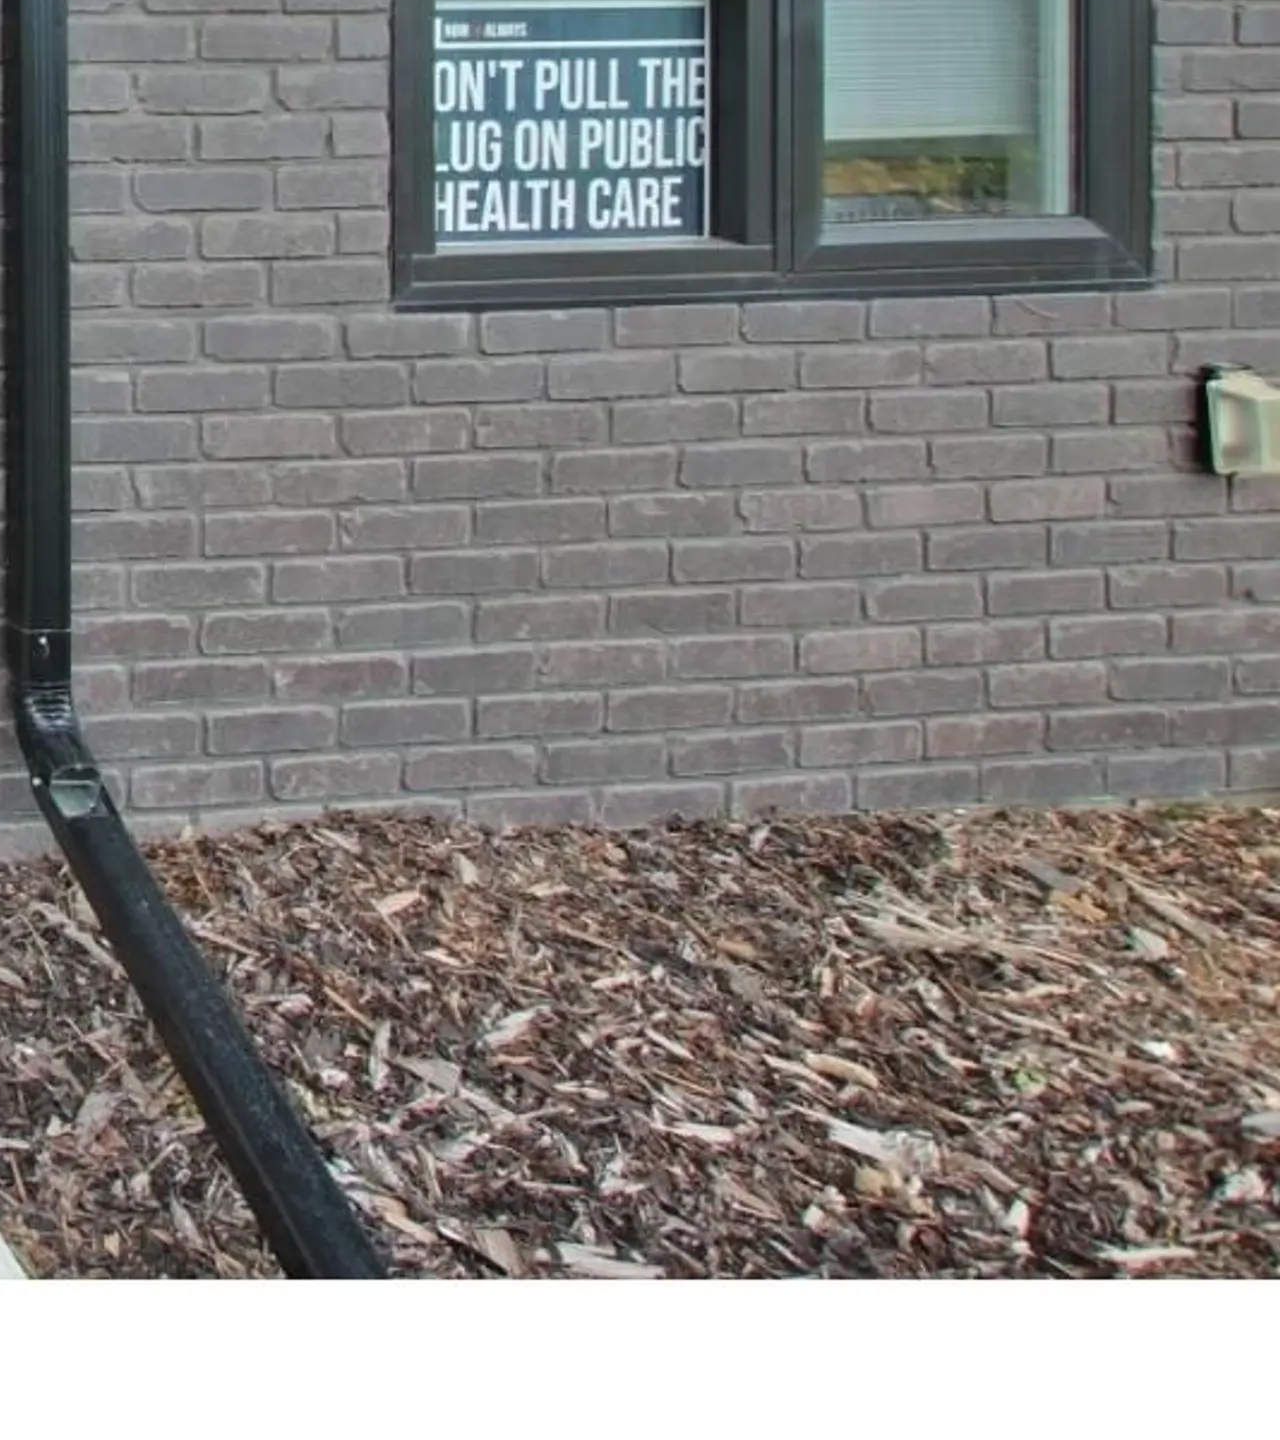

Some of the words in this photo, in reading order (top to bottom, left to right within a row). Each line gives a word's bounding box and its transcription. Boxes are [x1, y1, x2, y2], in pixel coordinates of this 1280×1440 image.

[435, 60, 524, 111] ON'T
[535, 59, 629, 110] PULL
[638, 57, 705, 109] THE
[435, 119, 502, 172] UG
[514, 119, 567, 172] ON
[579, 115, 705, 170] PUBLIC
[435, 178, 576, 232] HEALTH
[587, 175, 683, 229] CARE
